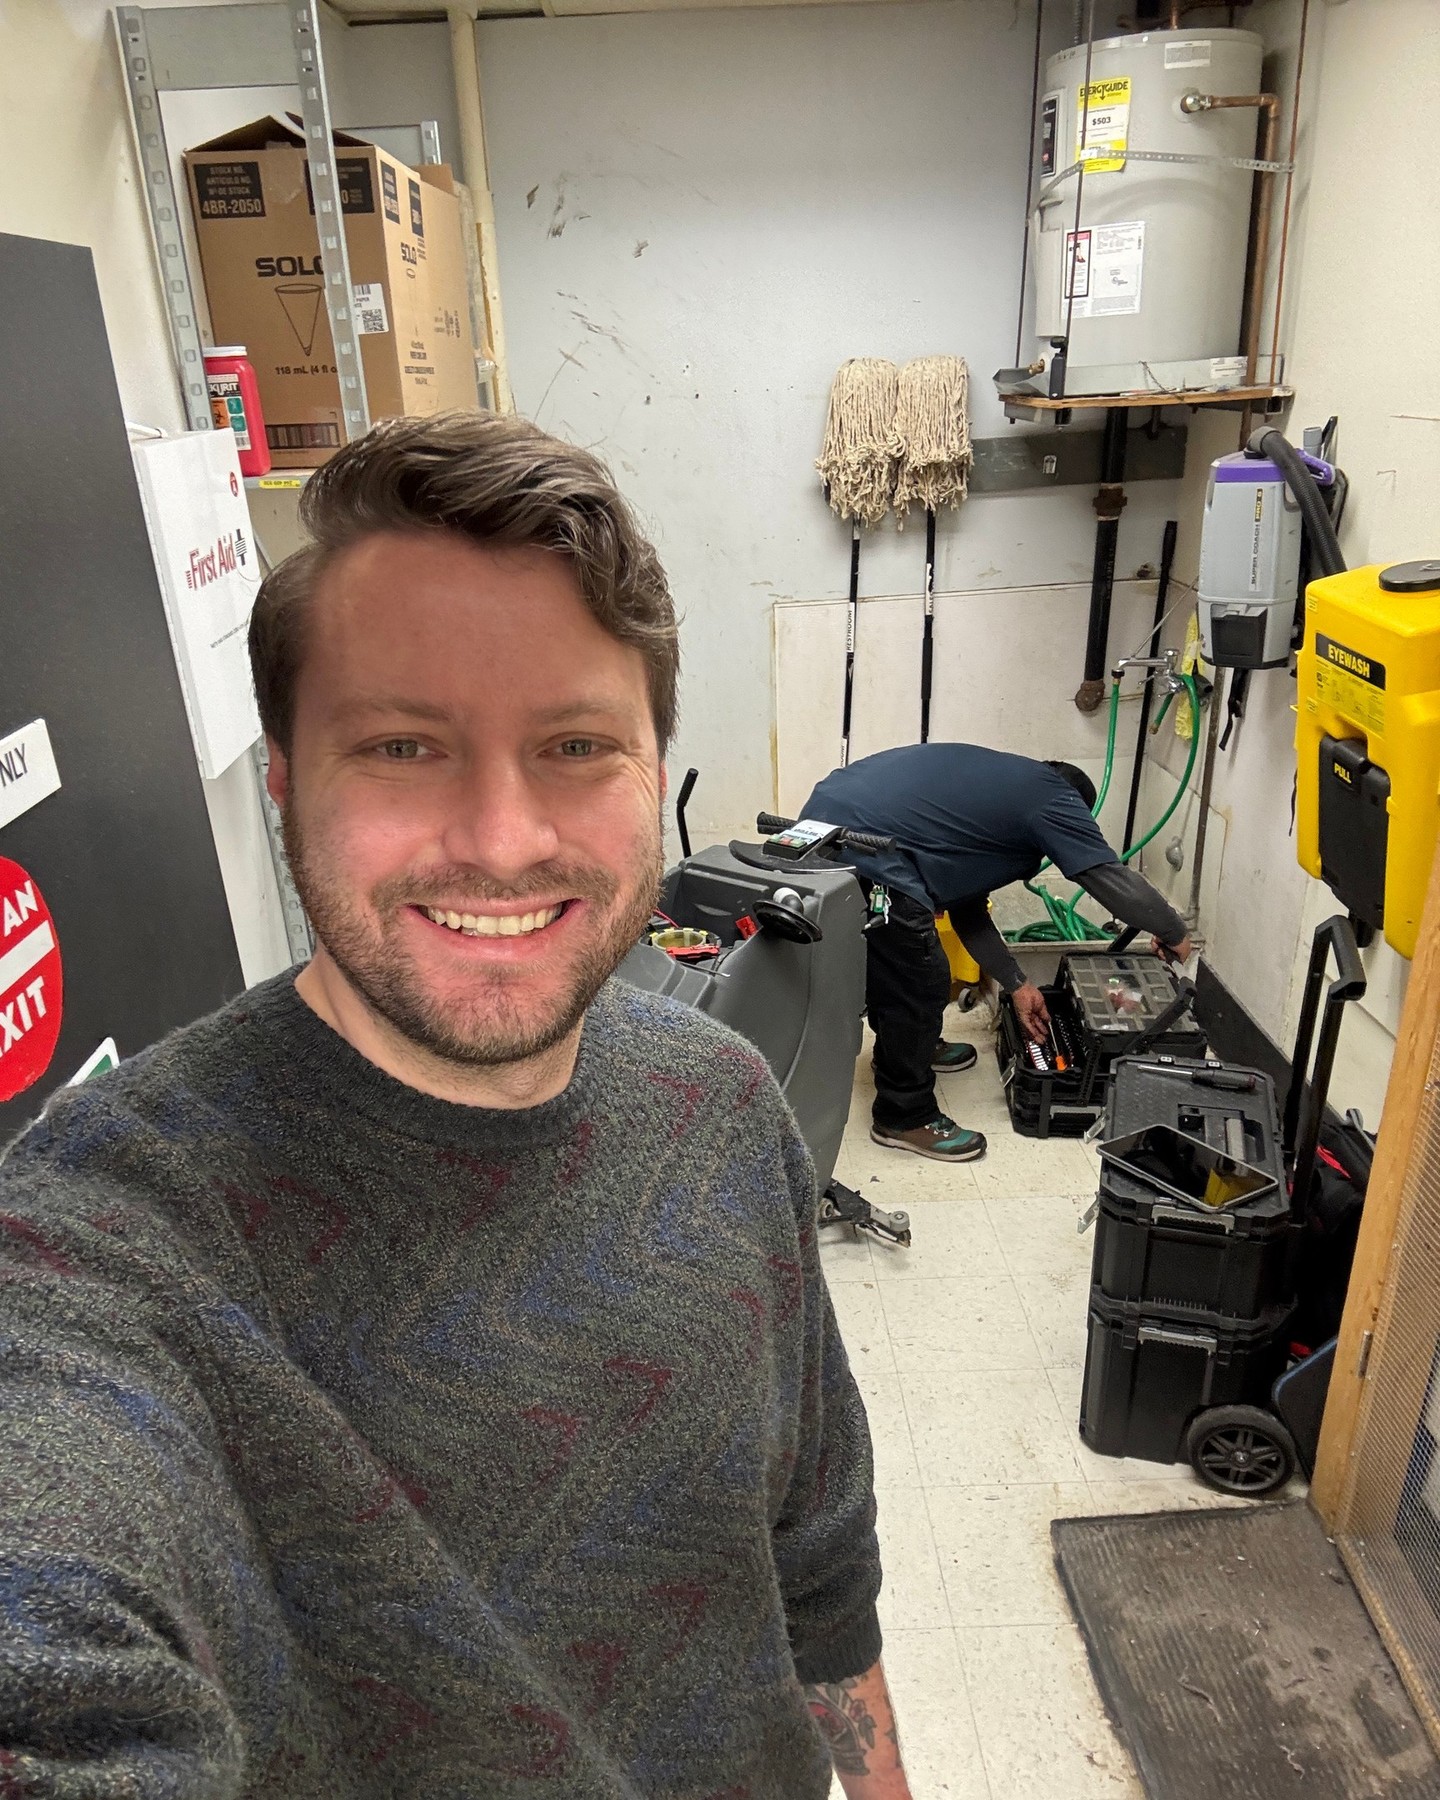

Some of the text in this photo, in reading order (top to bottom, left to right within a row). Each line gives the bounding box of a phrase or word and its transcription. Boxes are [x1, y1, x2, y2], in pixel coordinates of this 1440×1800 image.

[1080, 81, 1128, 97] EERGYGUIDE
[1092, 116, 1111, 126] $503
[202, 198, 262, 214] 4BR-2050
[275, 366, 291, 375] 118
[293, 365, 309, 374] mL
[310, 364, 319, 376] (4
[321, 364, 329, 374] fl
[1253, 524, 1261, 555] COACH
[189, 532, 237, 590] First Aid
[1328, 643, 1370, 678] EYEWASH
[1334, 762, 1352, 784] PULL
[0, 975, 47, 1058] XIT
